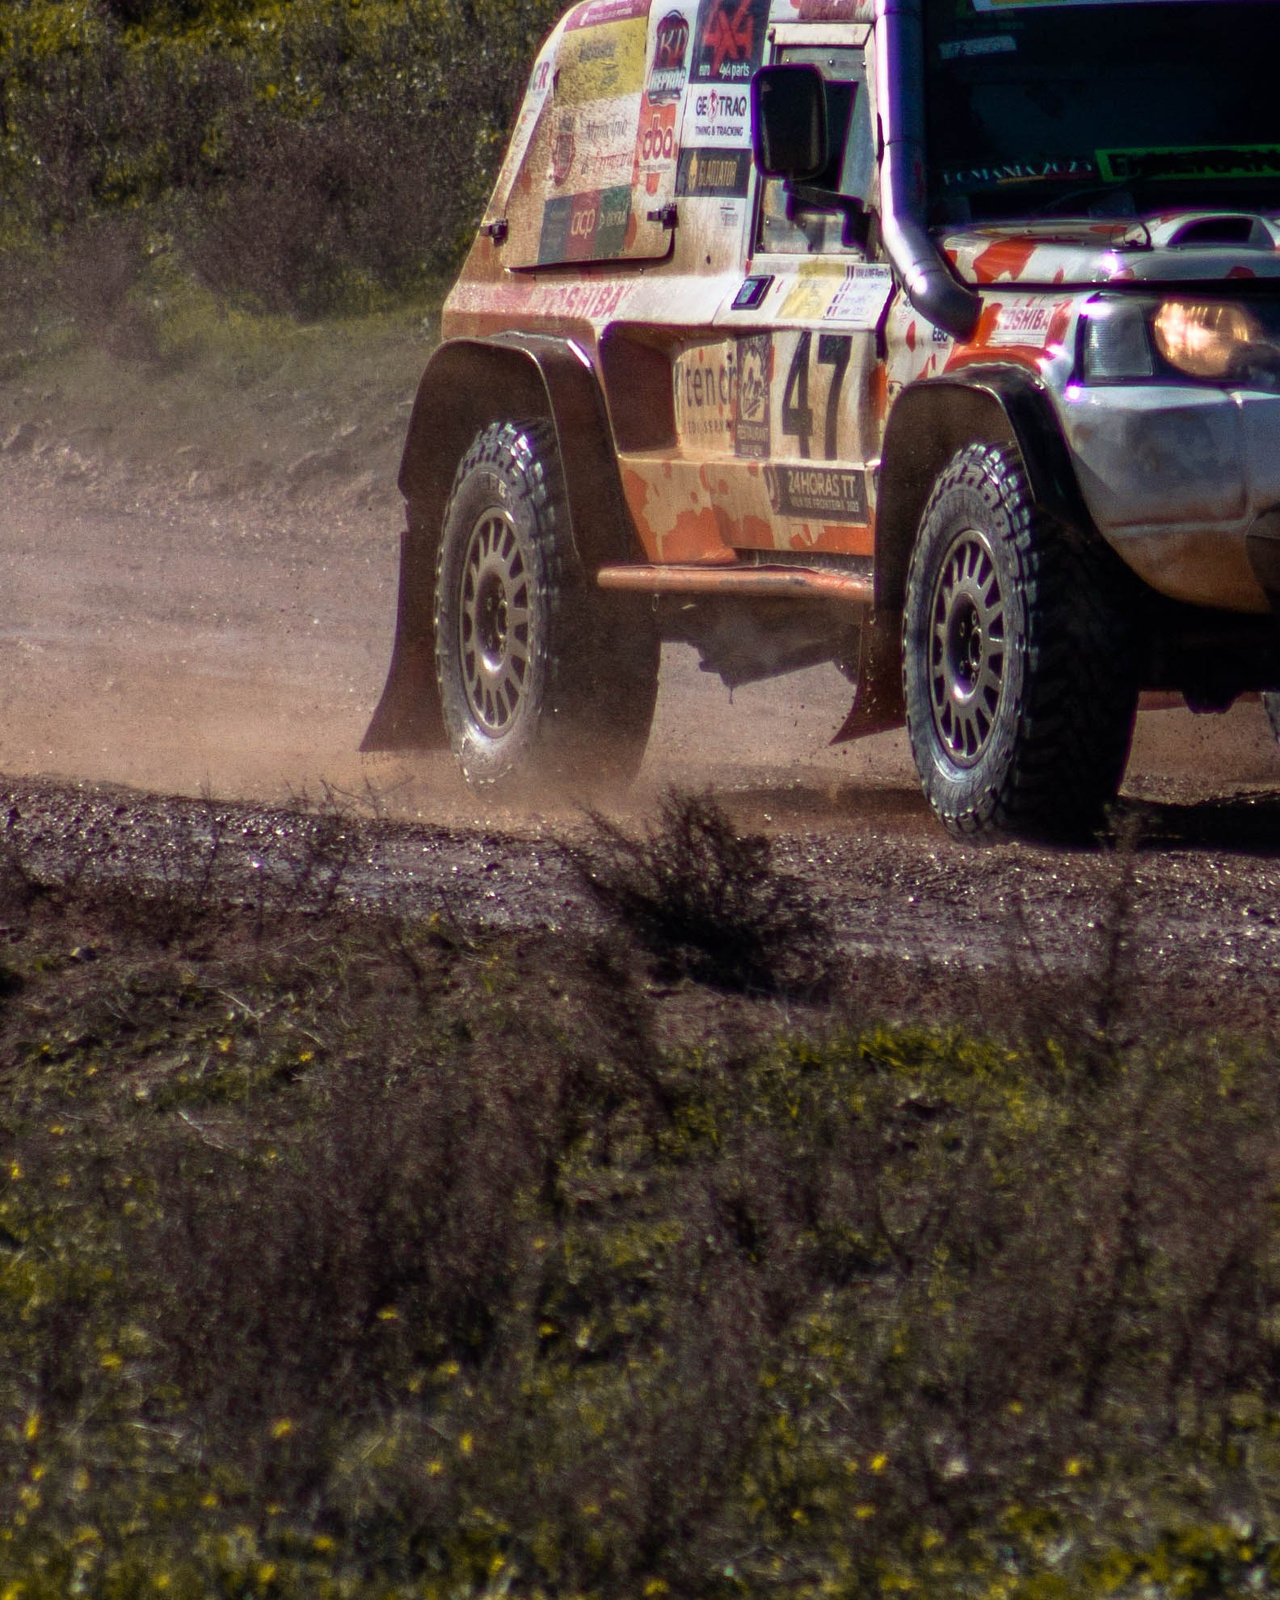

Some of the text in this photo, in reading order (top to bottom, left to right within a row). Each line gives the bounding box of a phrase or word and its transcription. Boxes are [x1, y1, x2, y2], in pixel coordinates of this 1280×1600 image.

[717, 126, 743, 137] TRACKING
[571, 208, 596, 239] acp
[782, 331, 853, 461] 47
[840, 475, 856, 499] TT
